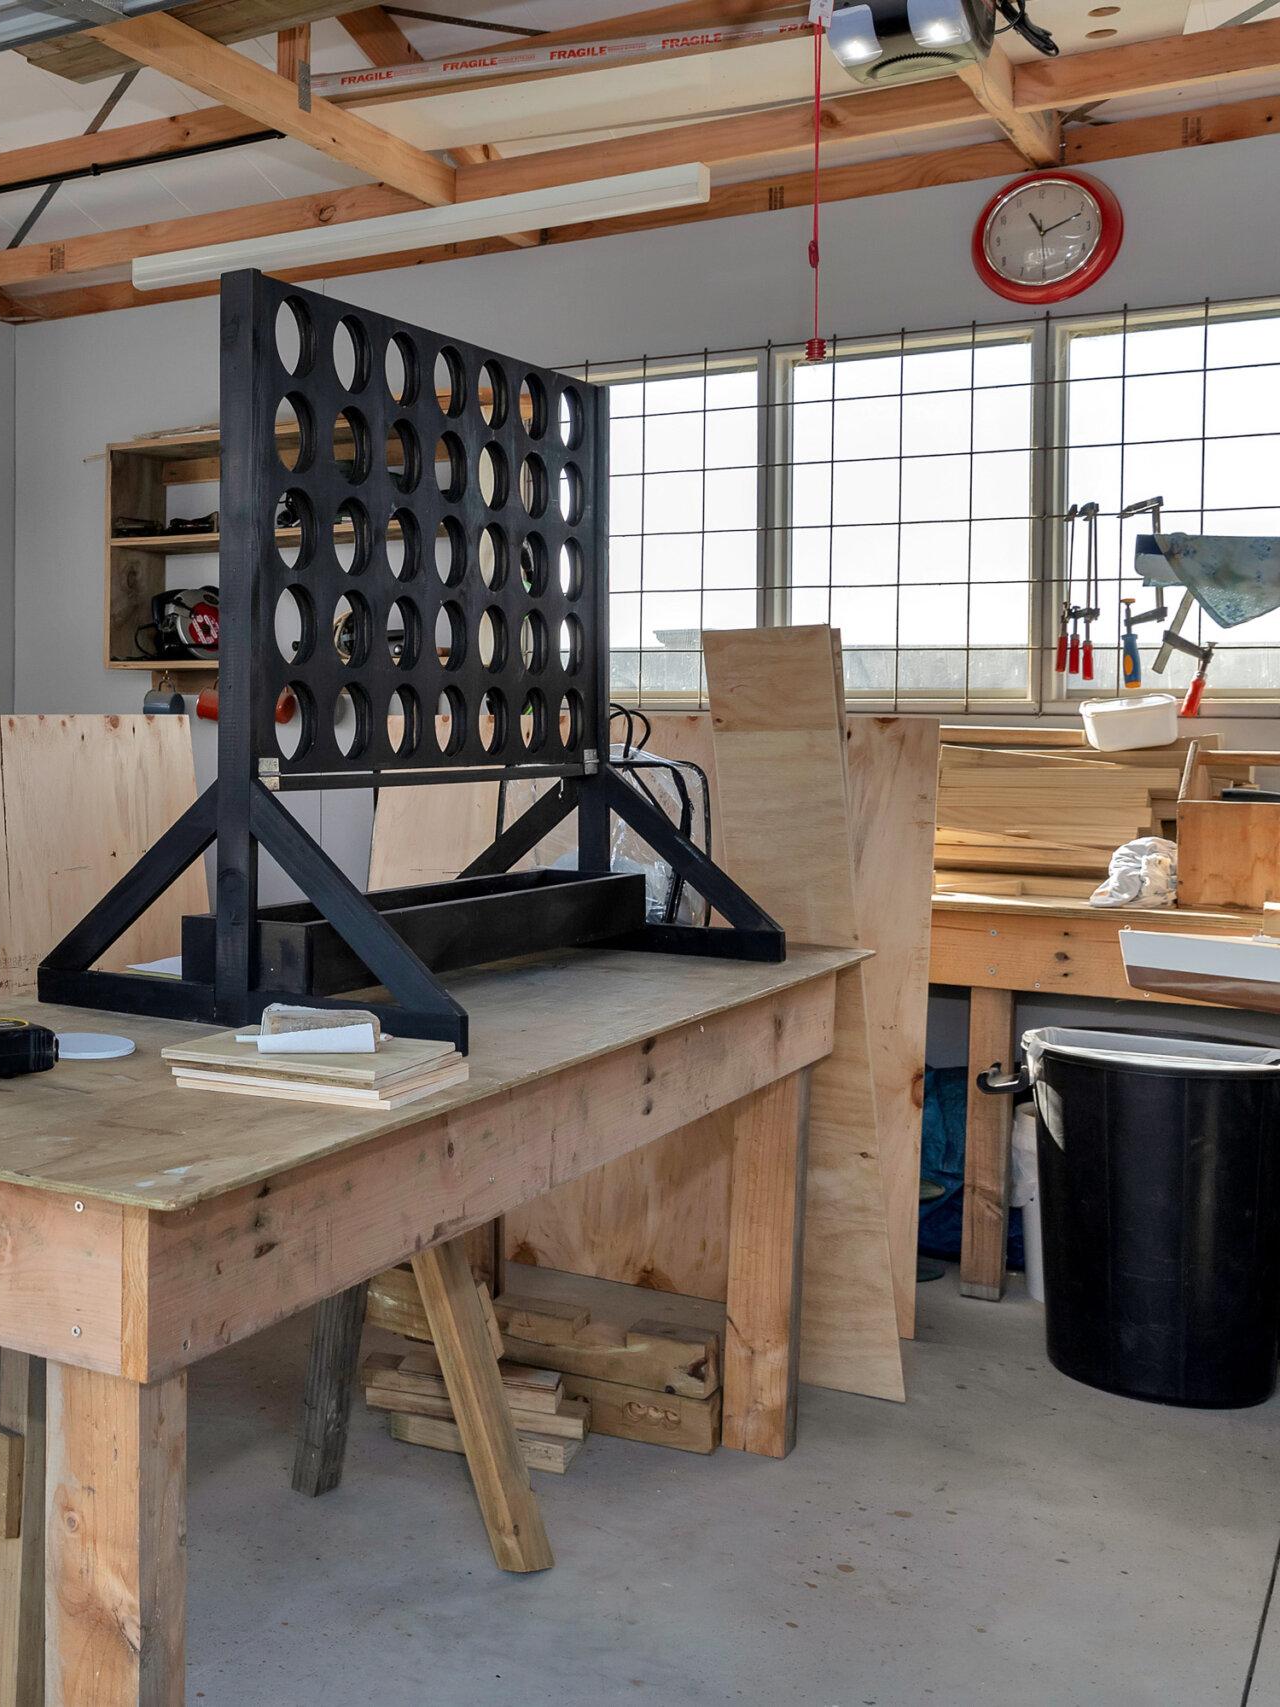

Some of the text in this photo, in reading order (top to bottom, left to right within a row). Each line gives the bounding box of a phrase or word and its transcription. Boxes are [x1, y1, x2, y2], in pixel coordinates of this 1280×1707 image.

[661, 33, 723, 50] FRAGILE
[549, 46, 608, 61] FRAGILE
[442, 57, 498, 72] FRAGILE
[340, 71, 394, 85] FRAGILE
